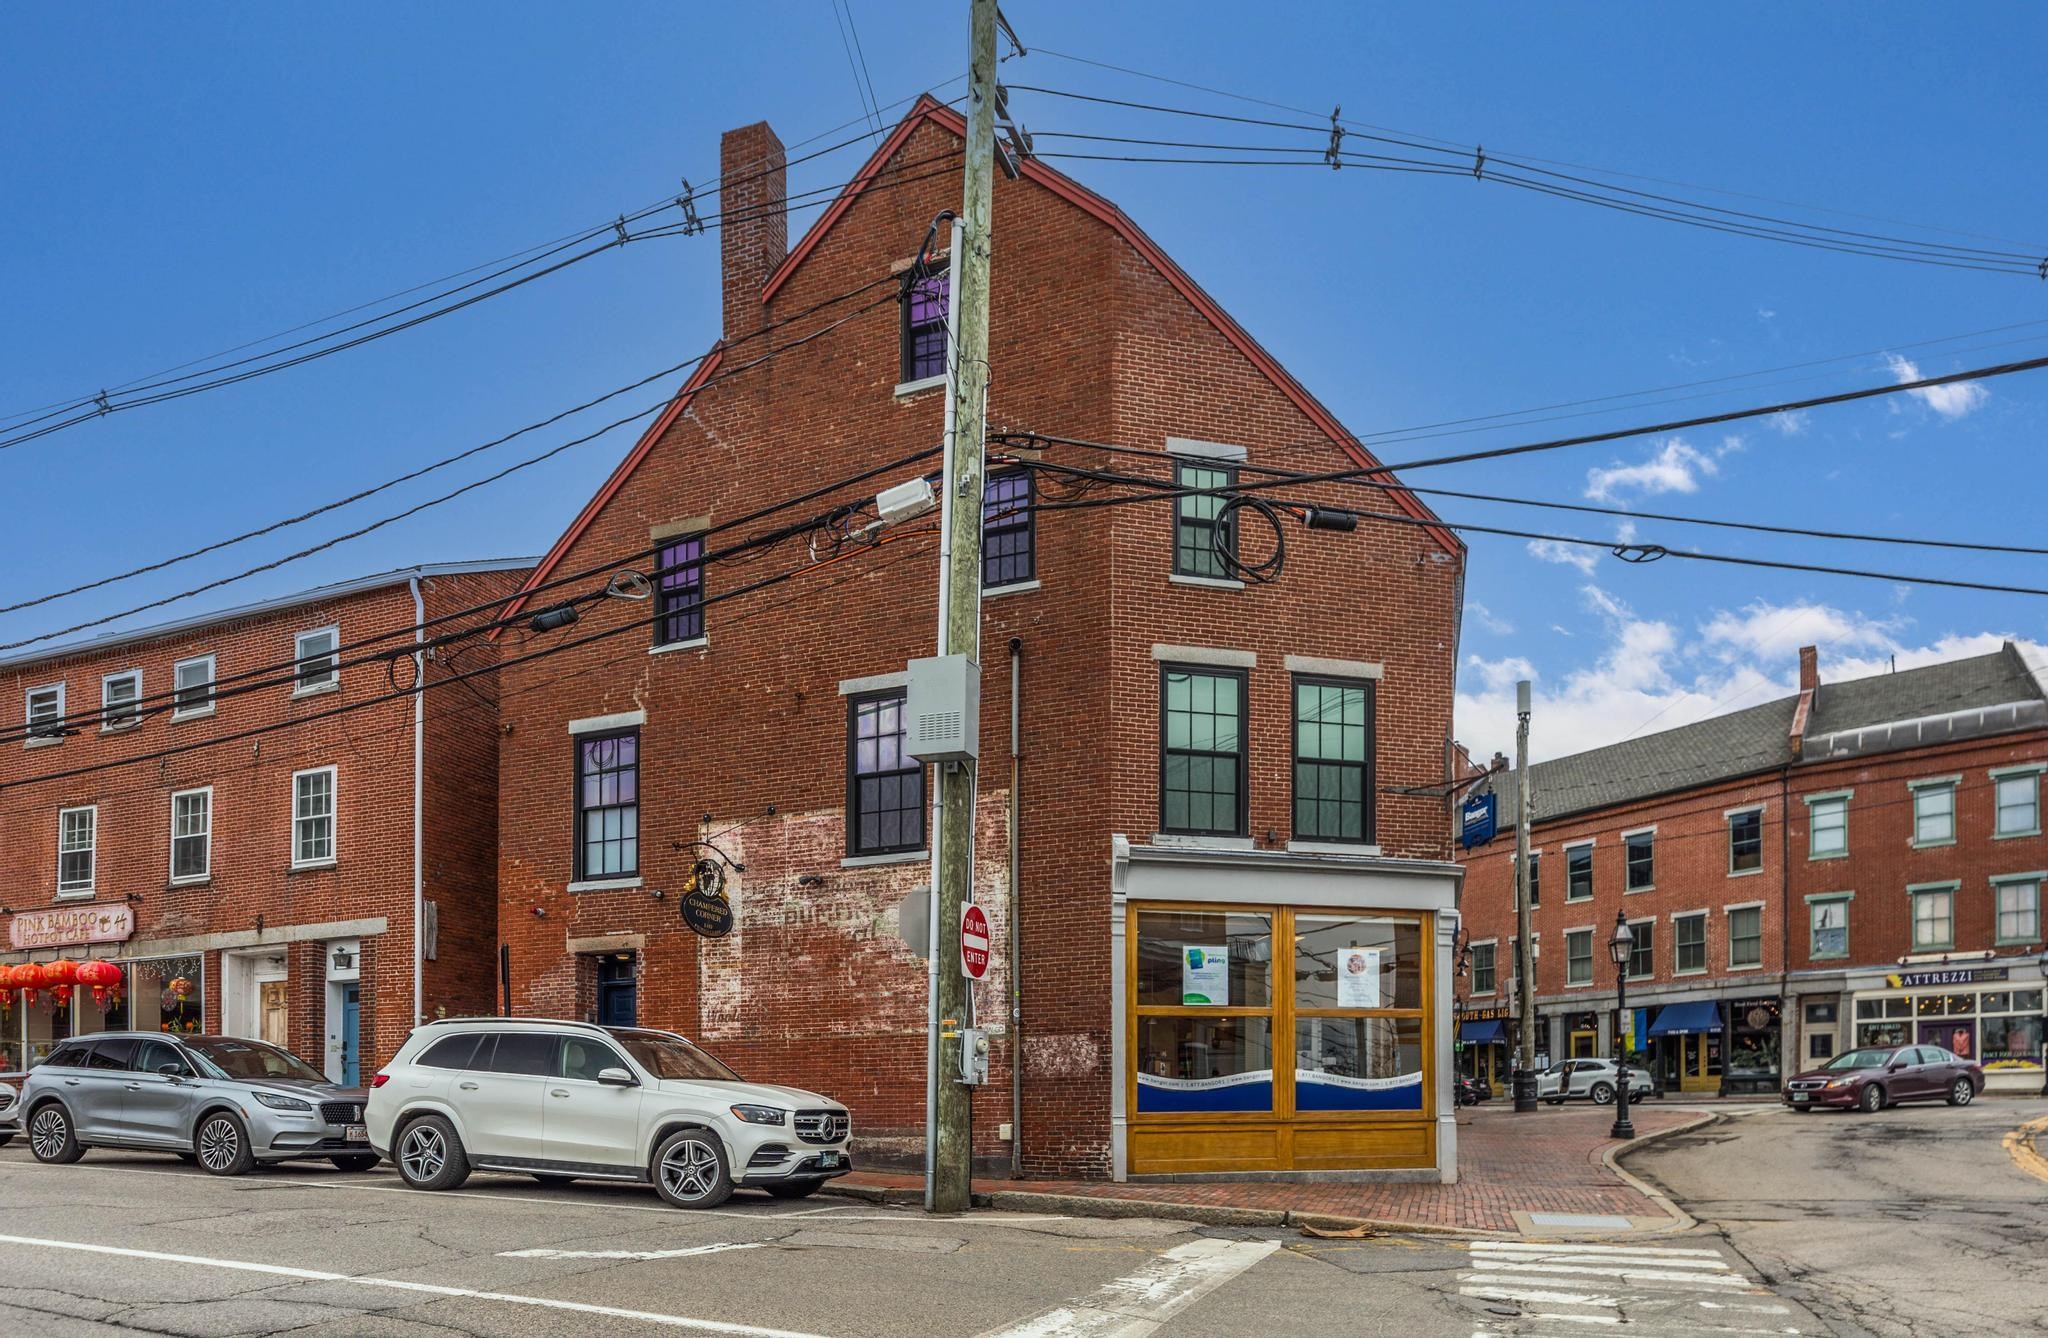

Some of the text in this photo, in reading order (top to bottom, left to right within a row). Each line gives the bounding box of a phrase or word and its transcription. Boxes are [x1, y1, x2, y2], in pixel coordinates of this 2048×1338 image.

[17, 912, 97, 932] PINK BAMBOO
[695, 909, 721, 922] CORNER
[965, 918, 986, 935] DO NOT
[23, 931, 63, 945] HOTPOT
[967, 950, 986, 966] ENTER
[1903, 970, 1972, 986] ATTREZZI
[1482, 1009, 1495, 1020] GAS
[1497, 1008, 1510, 1019] LIG
